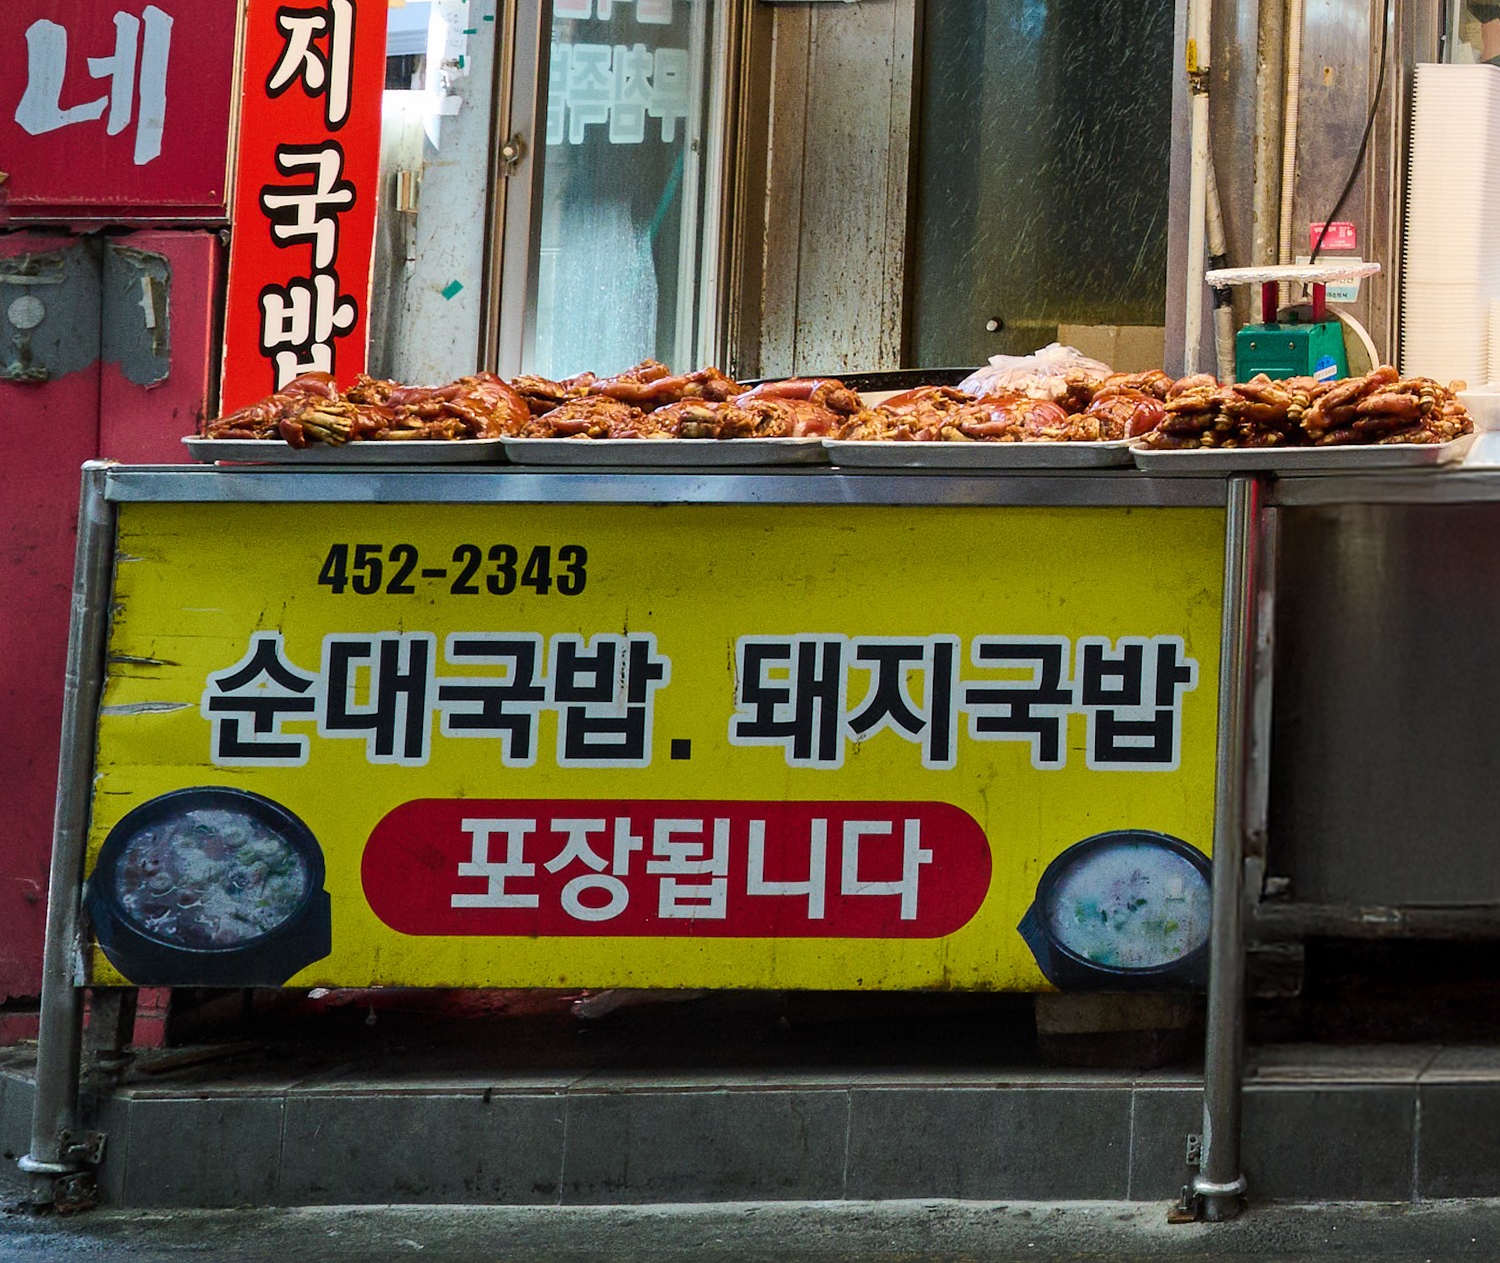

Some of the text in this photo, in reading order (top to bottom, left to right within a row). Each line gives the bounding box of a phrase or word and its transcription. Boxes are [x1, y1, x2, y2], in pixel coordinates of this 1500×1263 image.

[318, 543, 588, 596] 452-2343
[738, 636, 1192, 764] 돼지국밥
[449, 818, 933, 920] 포장됩니다
